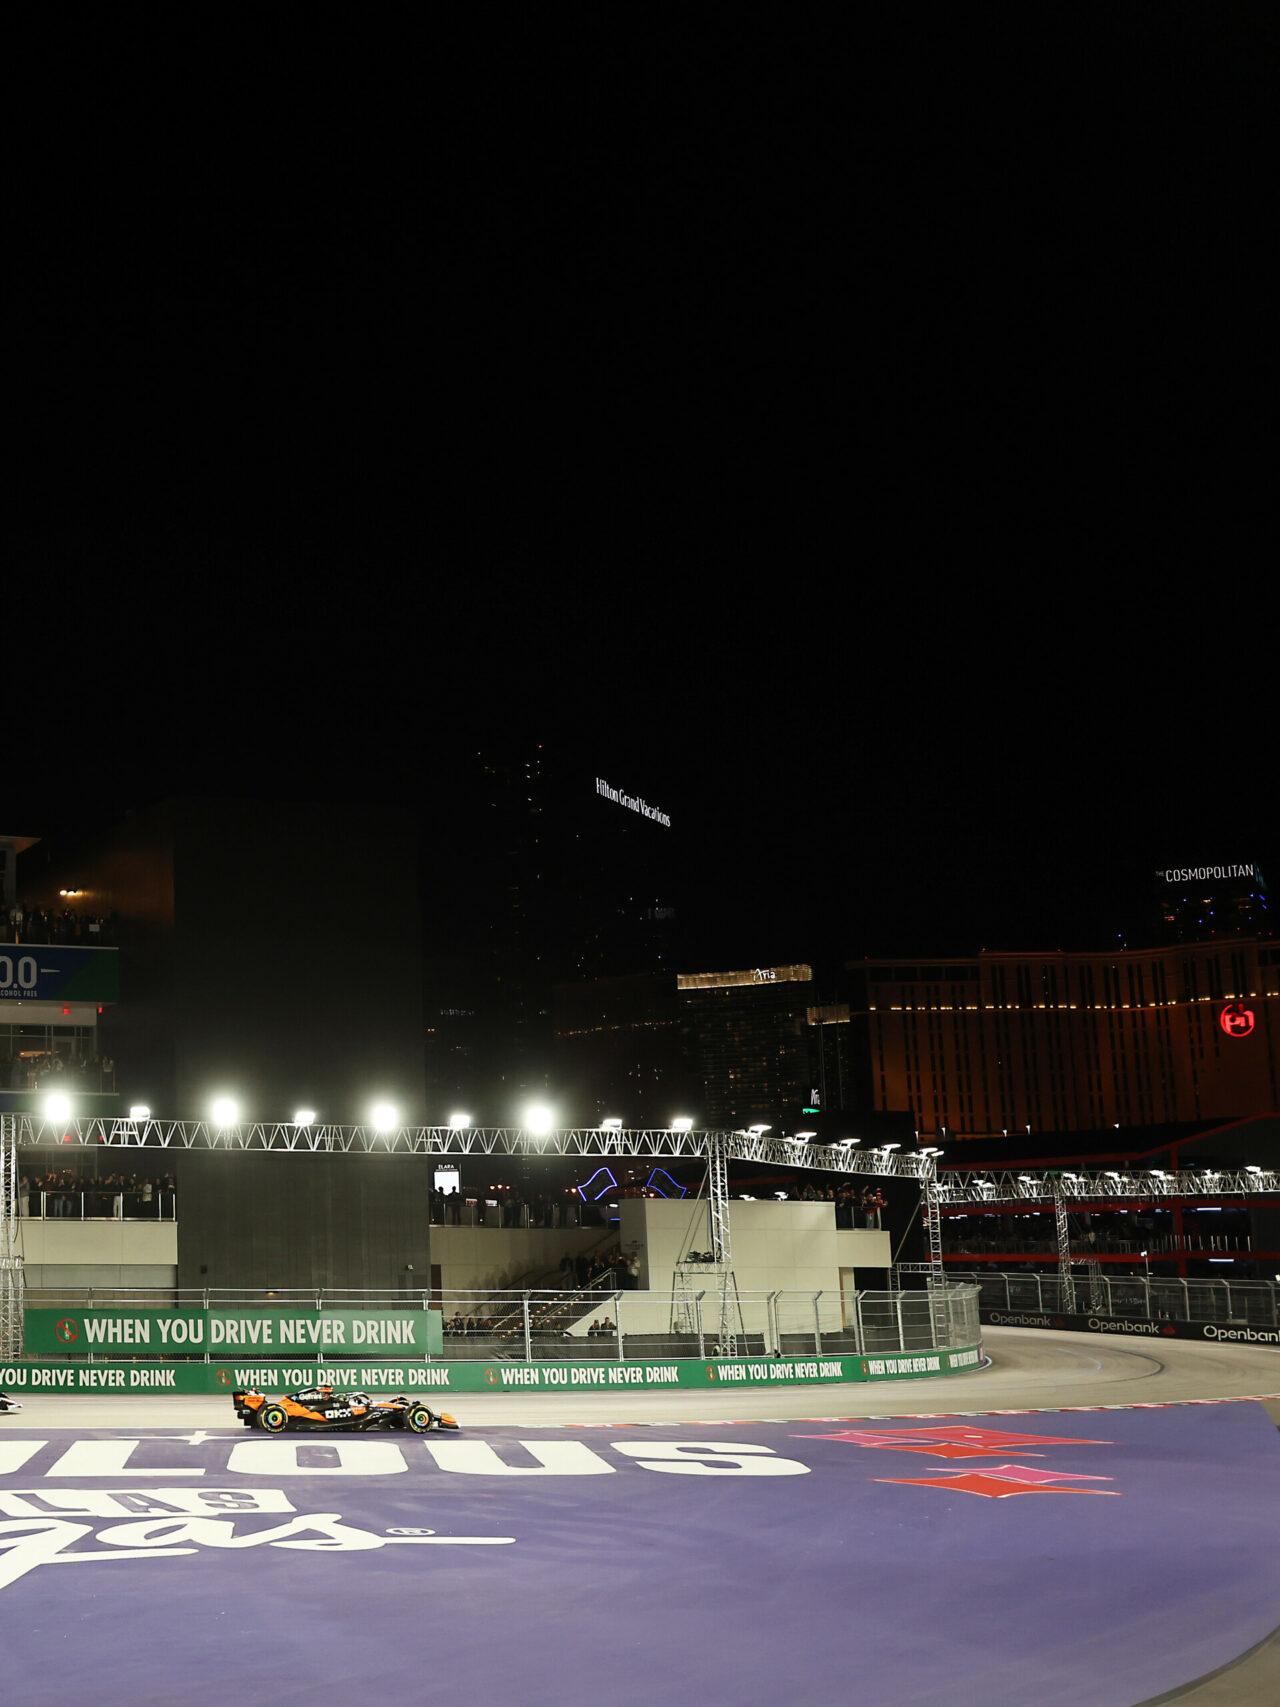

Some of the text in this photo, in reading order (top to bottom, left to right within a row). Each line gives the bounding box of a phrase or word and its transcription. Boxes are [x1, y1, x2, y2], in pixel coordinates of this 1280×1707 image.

[596, 777, 671, 827] Hilton Grand Vacations
[1165, 864, 1254, 882] COSMOPOLITAN
[753, 968, 776, 982] Aria
[990, 1312, 1052, 1327] Openbank
[1088, 1318, 1160, 1334] Openbank
[83, 1318, 416, 1344] WHEN YOU DRIVE NEVER DRINK
[1203, 1325, 1280, 1342] Openban
[500, 1366, 679, 1385] WHEN YOU DRIVE NEVER DRINK
[717, 1361, 843, 1381] WHEN YOU DRIVE NEVER DRINK
[868, 1359, 886, 1375] WHEN
[885, 1359, 898, 1374] YOU
[31, 1369, 75, 1386] DRIVE
[79, 1369, 126, 1387] NEVER
[130, 1369, 176, 1387] DRINK
[234, 1368, 450, 1386] WHEN YOU DRIVE NEVER DRINK
[3, 1490, 272, 1515] LAS
